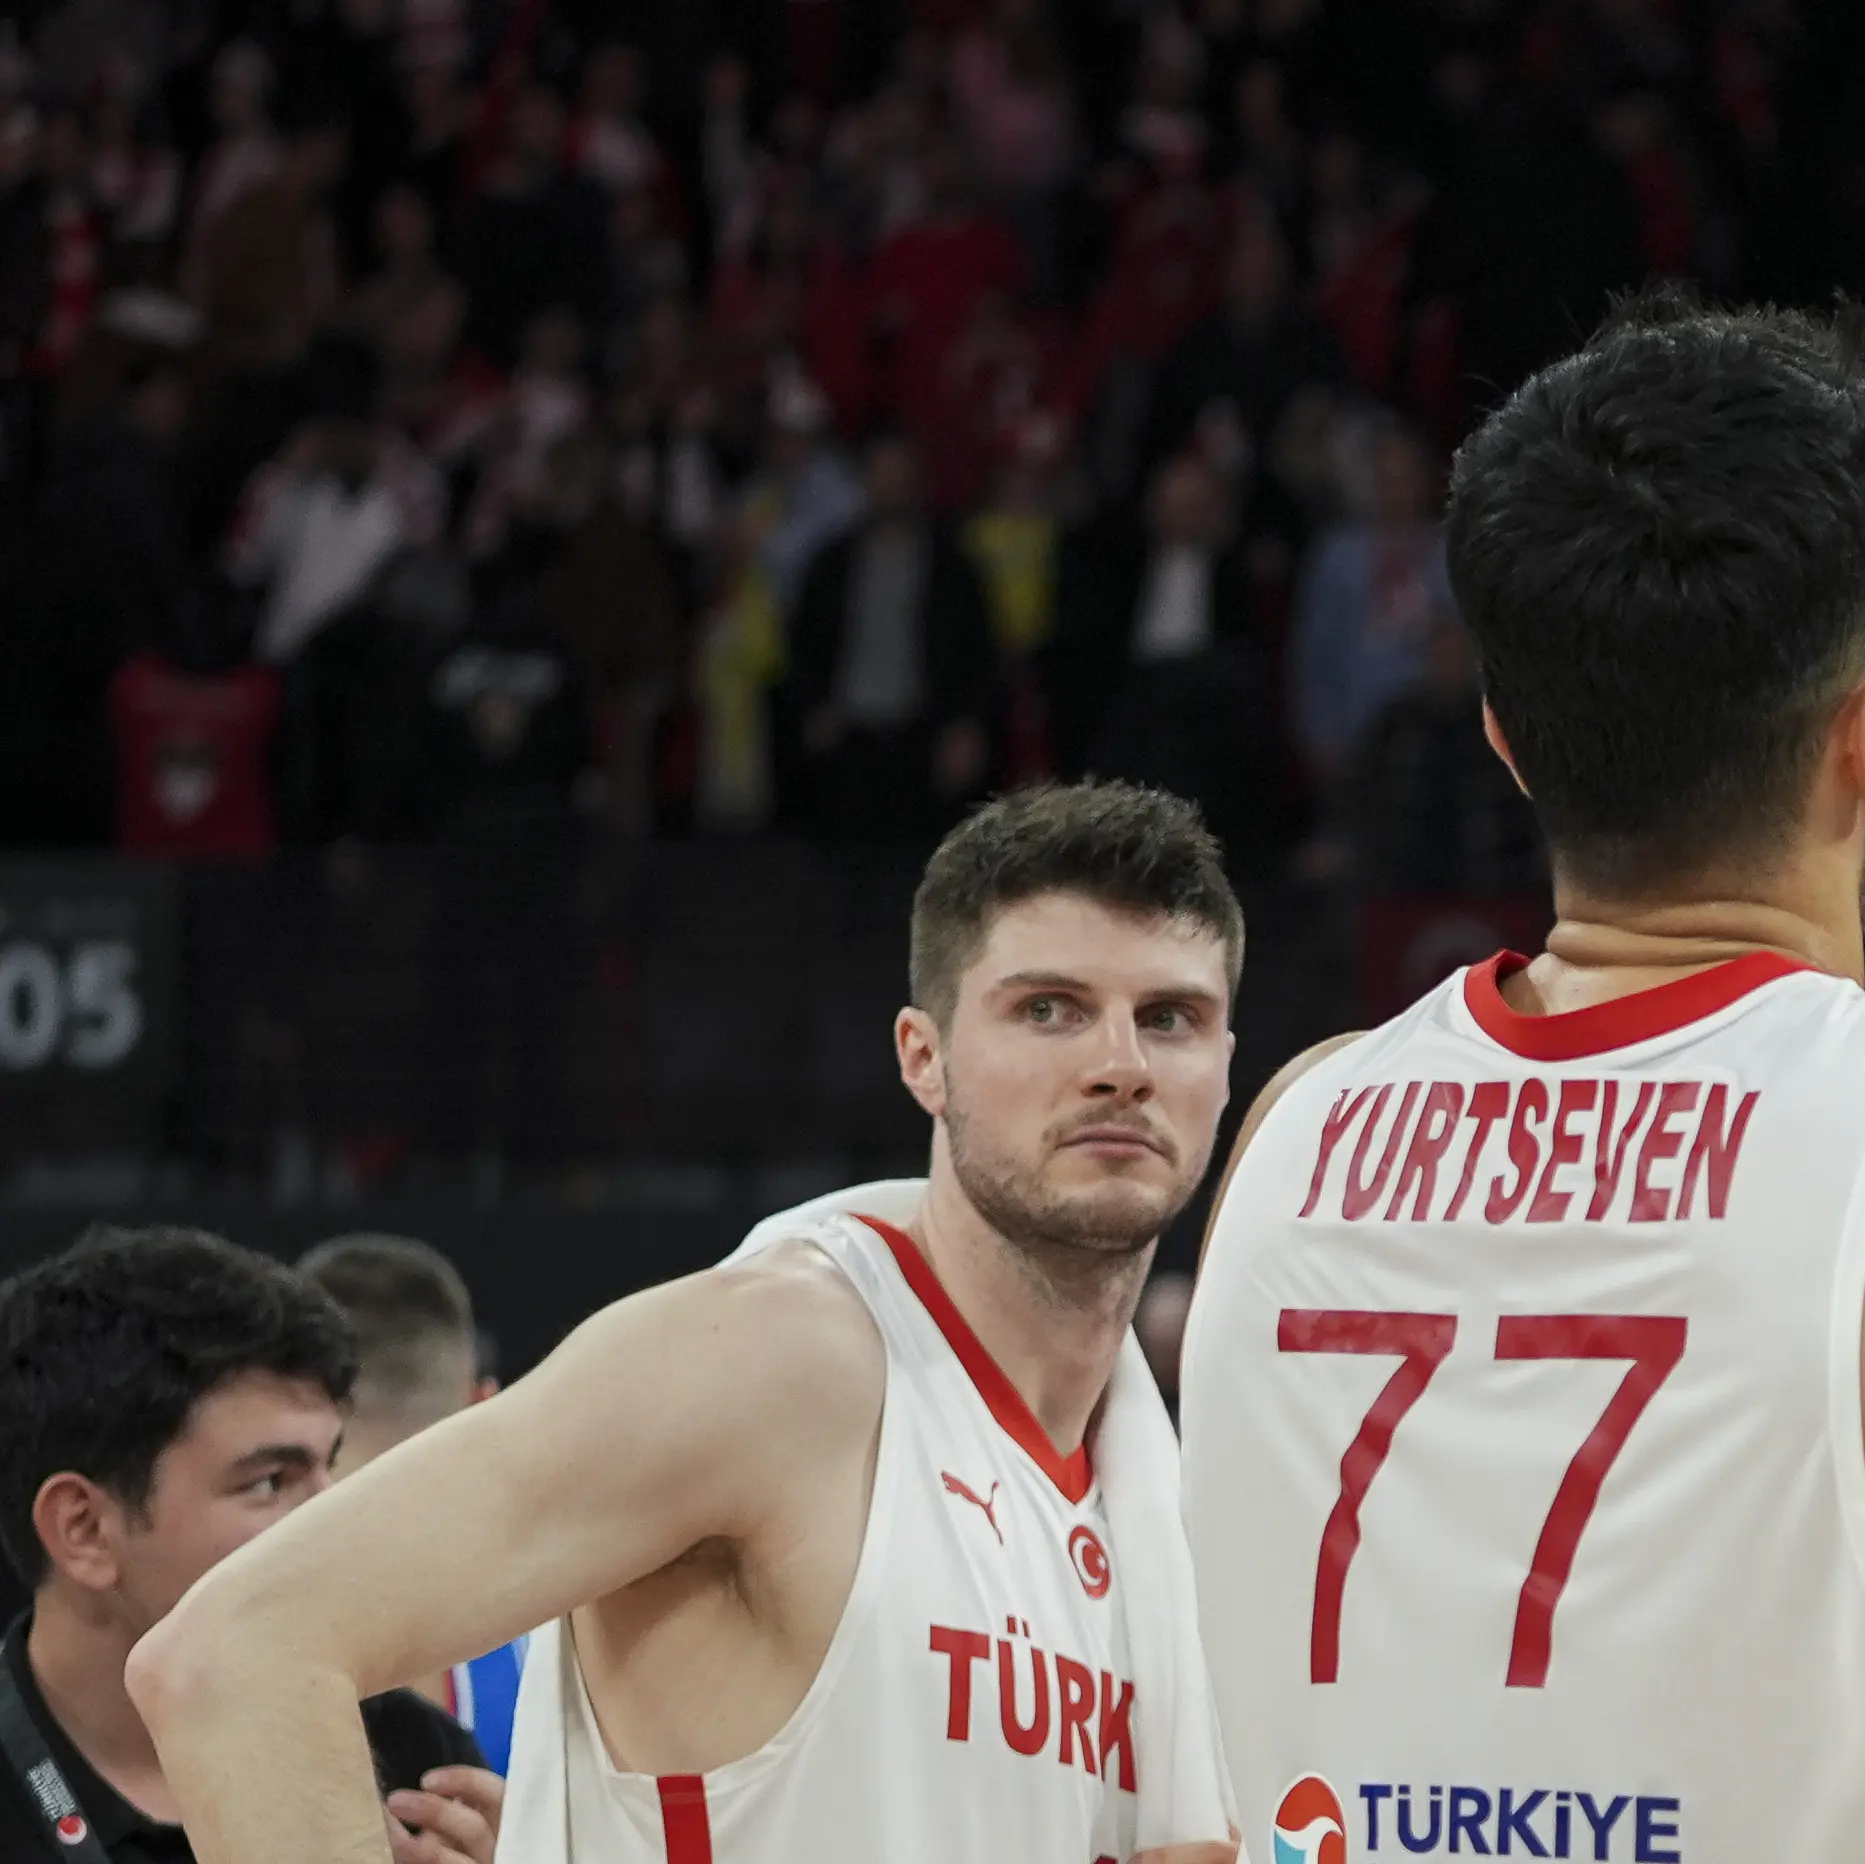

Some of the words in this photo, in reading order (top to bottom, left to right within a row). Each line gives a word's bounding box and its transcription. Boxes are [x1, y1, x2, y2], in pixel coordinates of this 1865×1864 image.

[1299, 1077, 1761, 1225] YURTSEVEN
[1276, 1307, 1689, 1689] 77
[929, 1614, 1138, 1794] TÜRK
